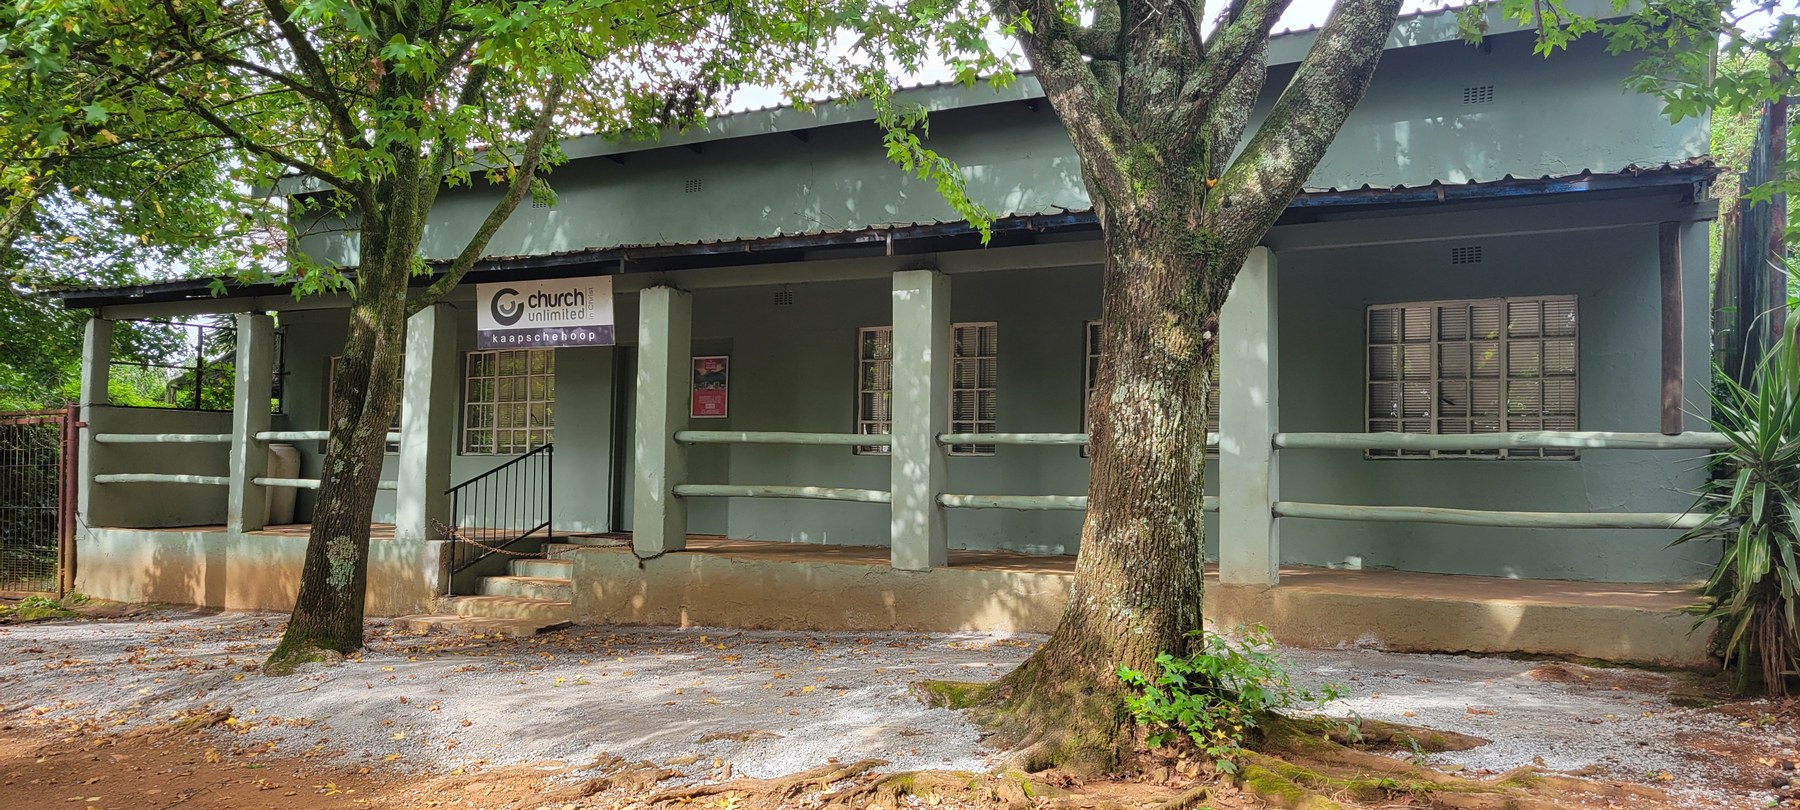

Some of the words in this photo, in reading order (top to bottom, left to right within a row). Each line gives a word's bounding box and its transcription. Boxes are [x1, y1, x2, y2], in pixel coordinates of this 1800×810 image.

[529, 288, 584, 308] church
[529, 308, 585, 321] unlimited
[492, 332, 595, 344] kaapschehoop
